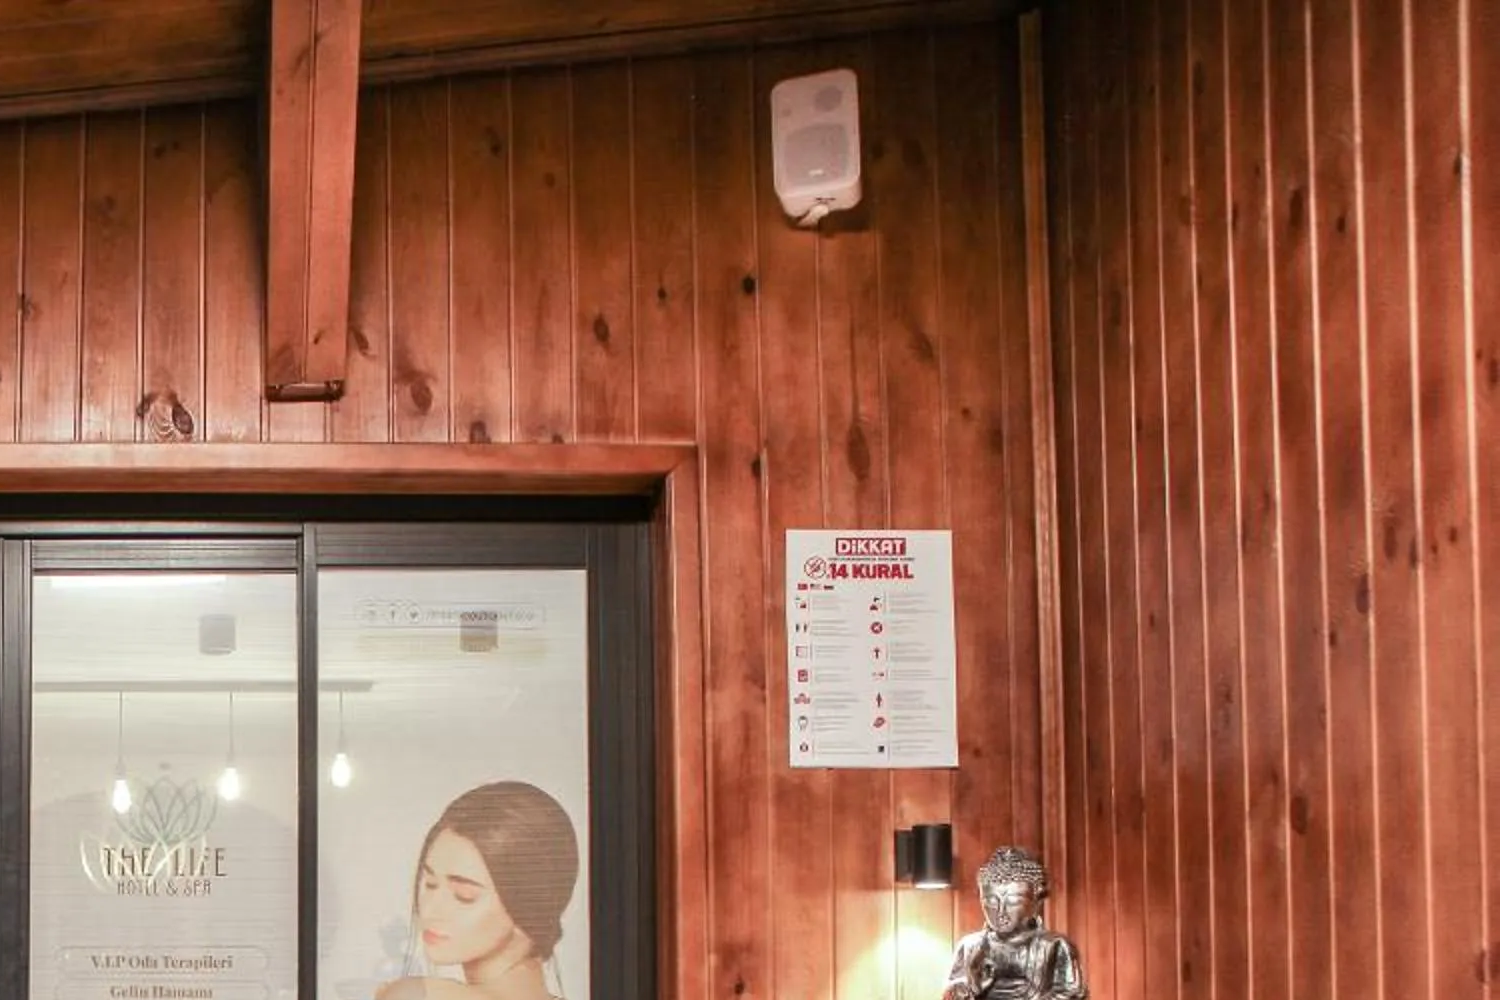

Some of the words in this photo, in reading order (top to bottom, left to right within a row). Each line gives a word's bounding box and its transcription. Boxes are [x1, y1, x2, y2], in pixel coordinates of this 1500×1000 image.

[838, 538, 904, 555] DİKKAT
[829, 563, 849, 579] 14
[852, 563, 914, 579] KURAL
[102, 847, 153, 877] THE
[174, 847, 228, 877] LIFE
[117, 879, 158, 896] HOTEL
[166, 879, 179, 896] &
[183, 879, 212, 896] SPA
[163, 954, 233, 972] Terapileri
